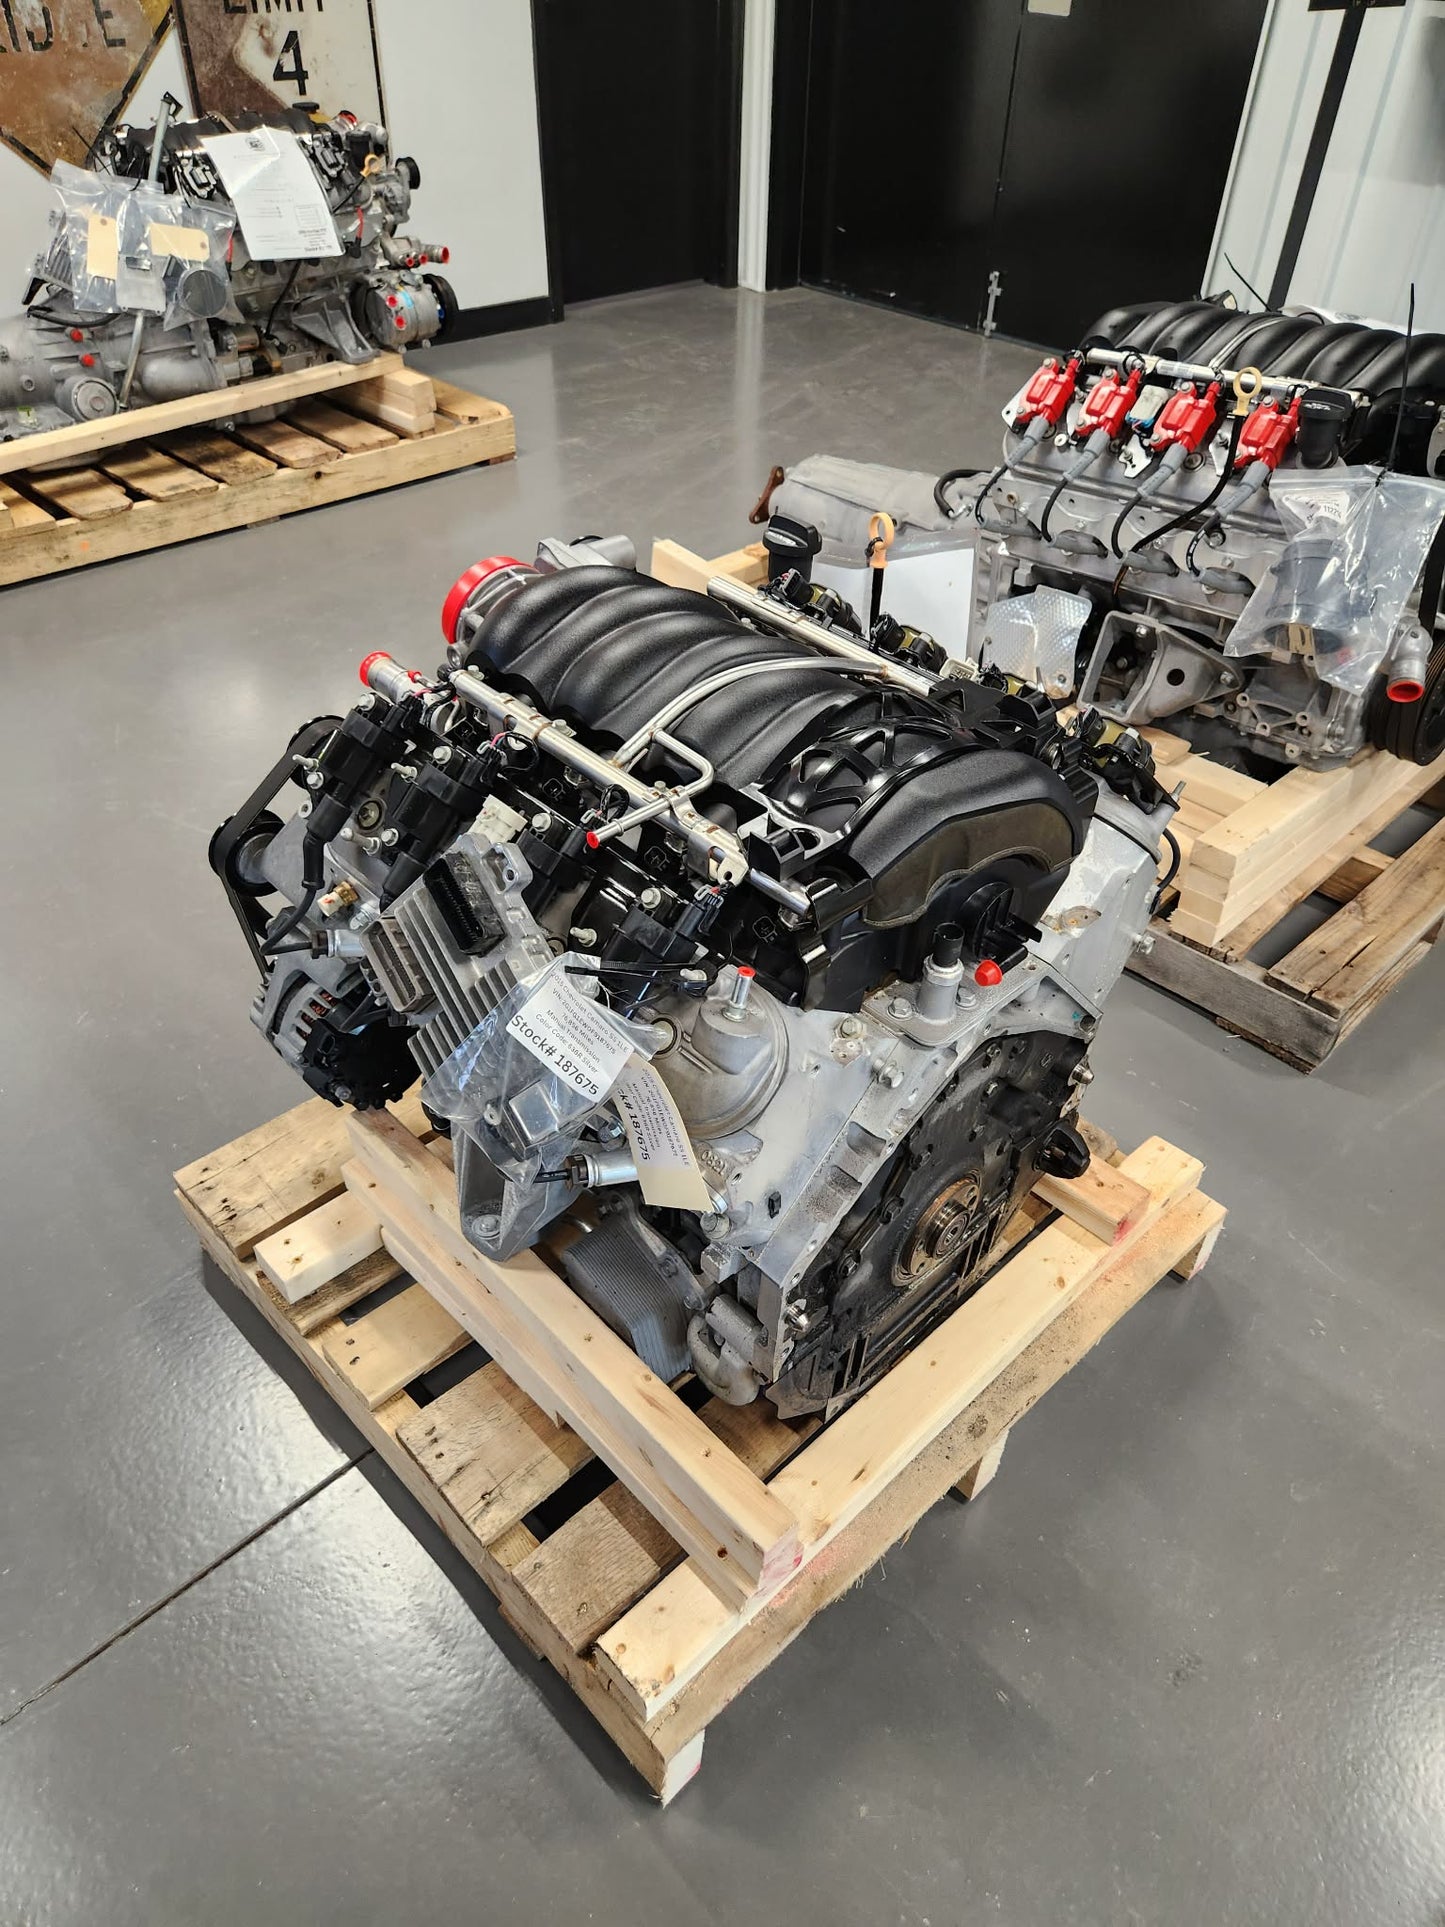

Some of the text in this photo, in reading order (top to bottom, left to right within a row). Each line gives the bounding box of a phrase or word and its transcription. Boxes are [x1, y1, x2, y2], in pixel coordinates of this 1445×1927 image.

[272, 30, 309, 96] 4
[535, 1013, 552, 1029] Color
[551, 1028, 568, 1045] Code:
[581, 1057, 598, 1074] Silver
[546, 1010, 600, 1062] Manual Transmission
[561, 1013, 593, 1045] 76,856 Miles
[563, 985, 586, 1012] Chevrolet
[586, 1012, 608, 1034] Camaro
[608, 1033, 617, 1042] SS
[616, 1041, 628, 1052] 1LE
[512, 1014, 599, 1095] Stock# 187675
[629, 1111, 650, 1161] 187675
